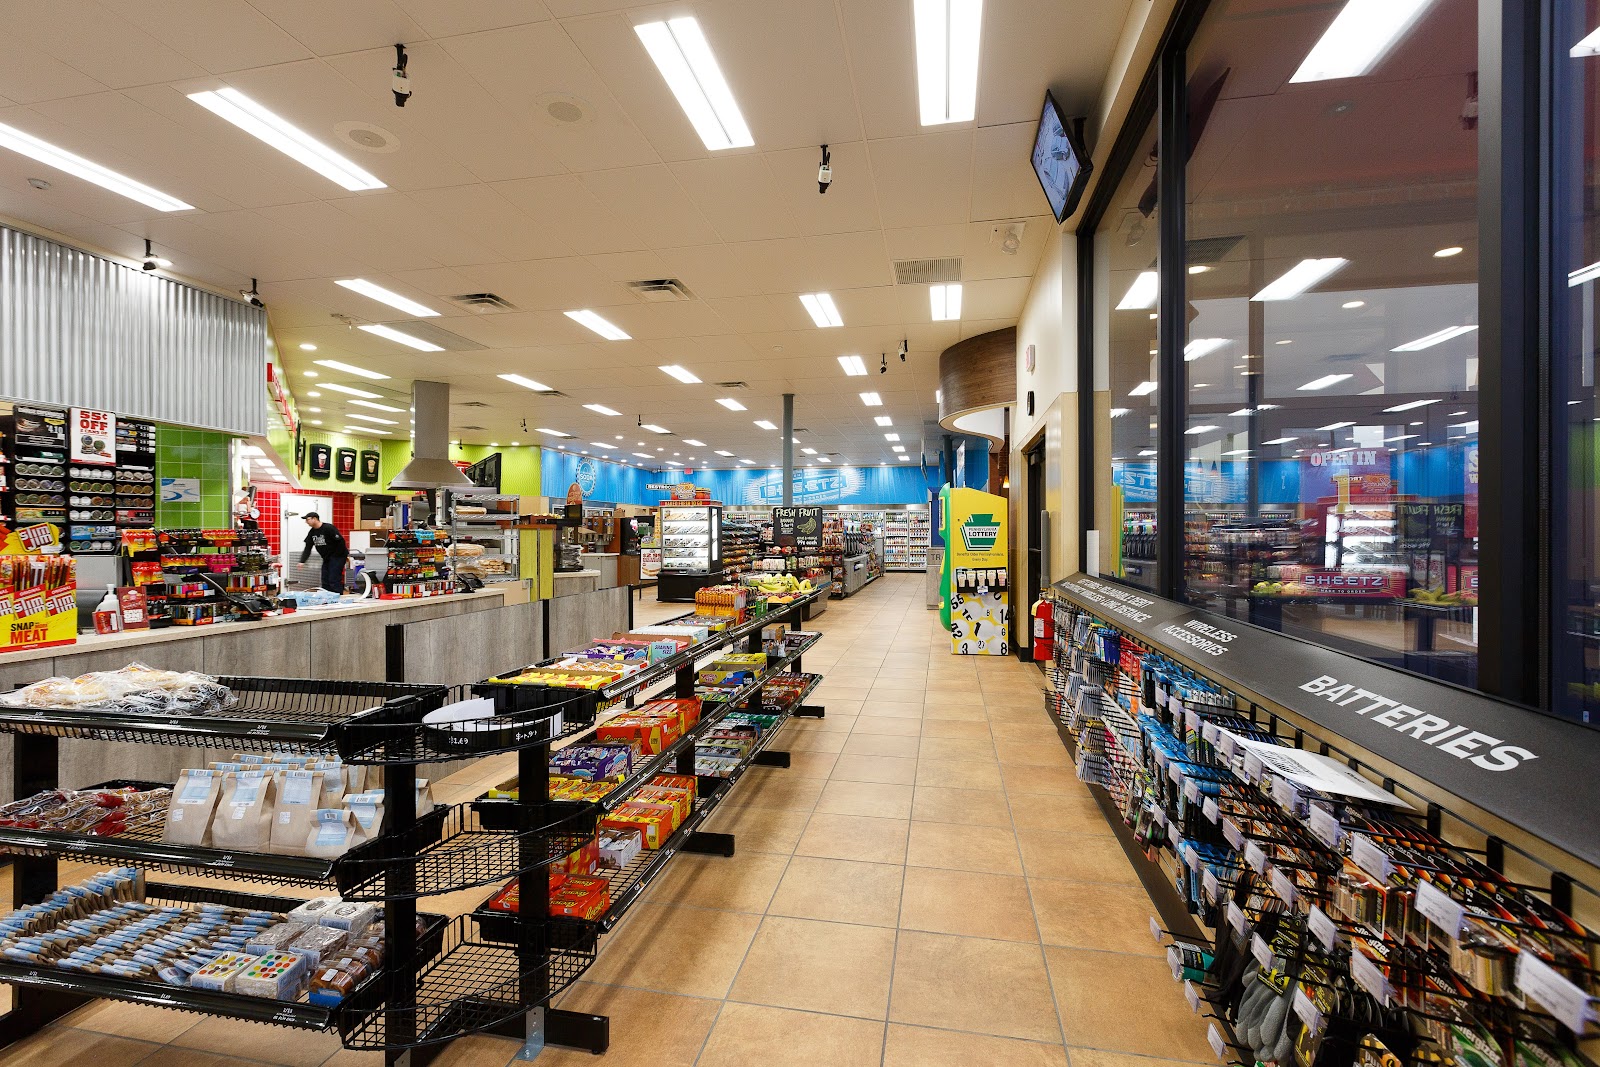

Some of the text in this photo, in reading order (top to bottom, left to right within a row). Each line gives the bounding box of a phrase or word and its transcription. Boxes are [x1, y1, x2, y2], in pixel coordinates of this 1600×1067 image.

[80, 411, 107, 421] 55¢
[80, 420, 108, 430] OFF
[1311, 450, 1376, 467] OPEN IN
[776, 508, 820, 517] FRESH FRUIT
[1305, 575, 1383, 586] SHEETZ
[11, 622, 35, 631] SNAP
[1184, 619, 1238, 643] WIRELESS
[10, 629, 49, 644] MEAT
[1162, 625, 1229, 656] ACCESSORIES
[1298, 675, 1540, 772] BATTERIES
